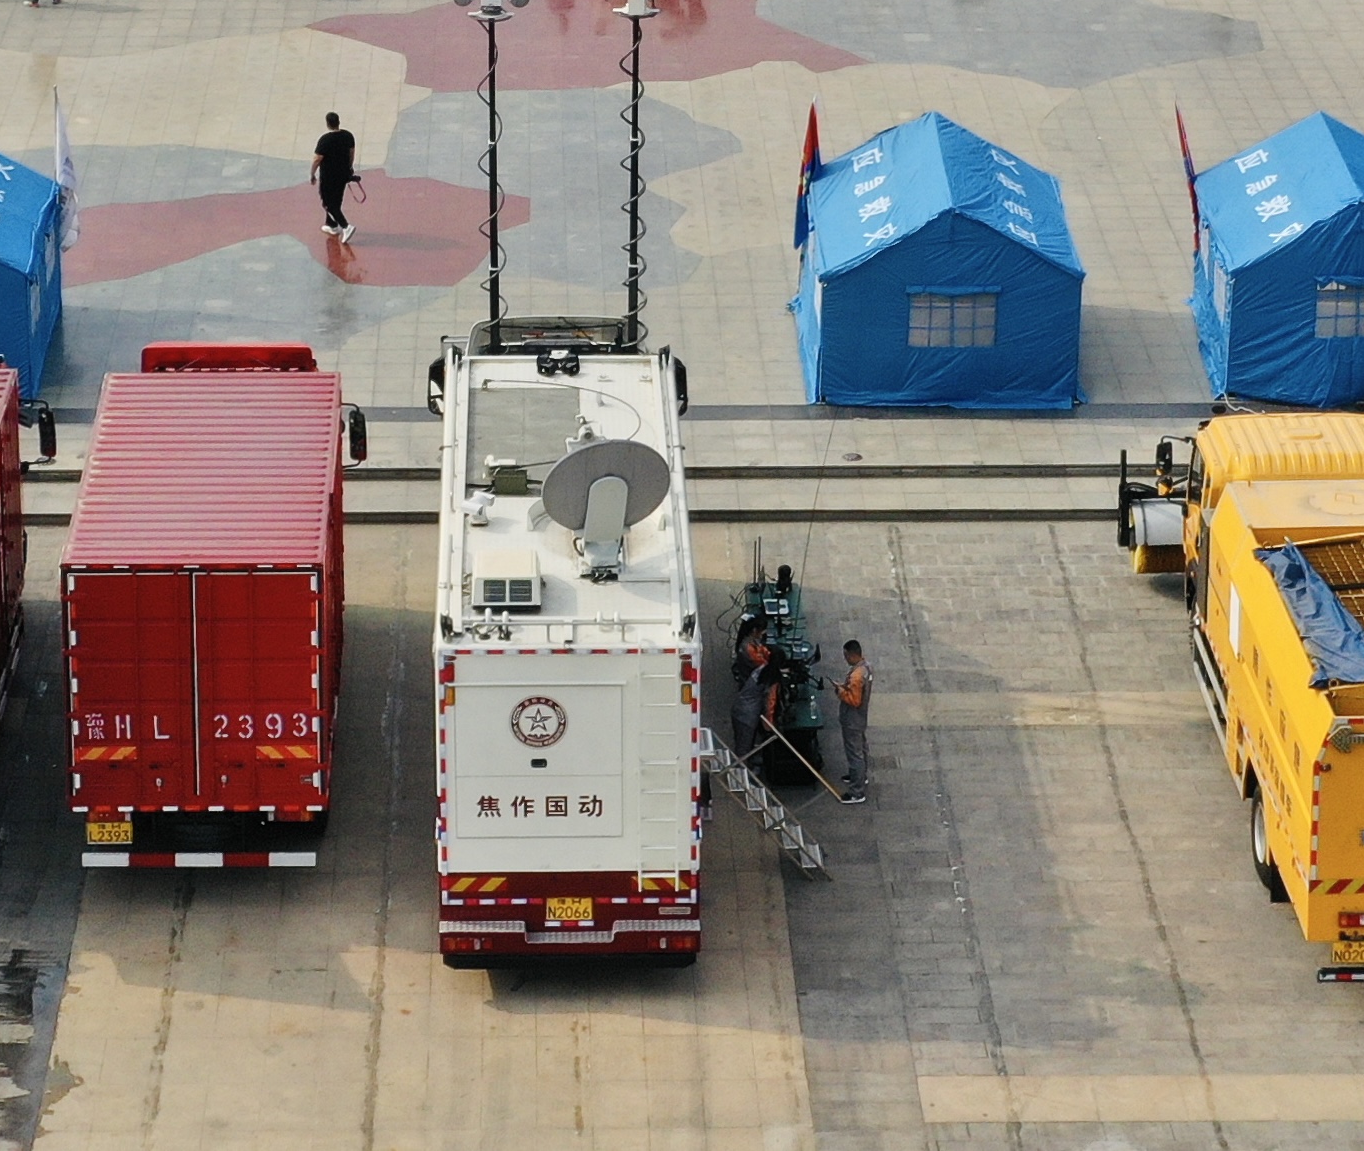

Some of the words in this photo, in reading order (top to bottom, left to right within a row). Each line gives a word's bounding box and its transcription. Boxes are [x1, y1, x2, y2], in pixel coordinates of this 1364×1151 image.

[851, 148, 898, 247] 应急救灾
[1234, 148, 1305, 244] 应急救灾
[213, 712, 308, 740] 2393
[476, 794, 604, 818] 焦作国动
[88, 829, 130, 843] L2393
[547, 906, 591, 920] N2066
